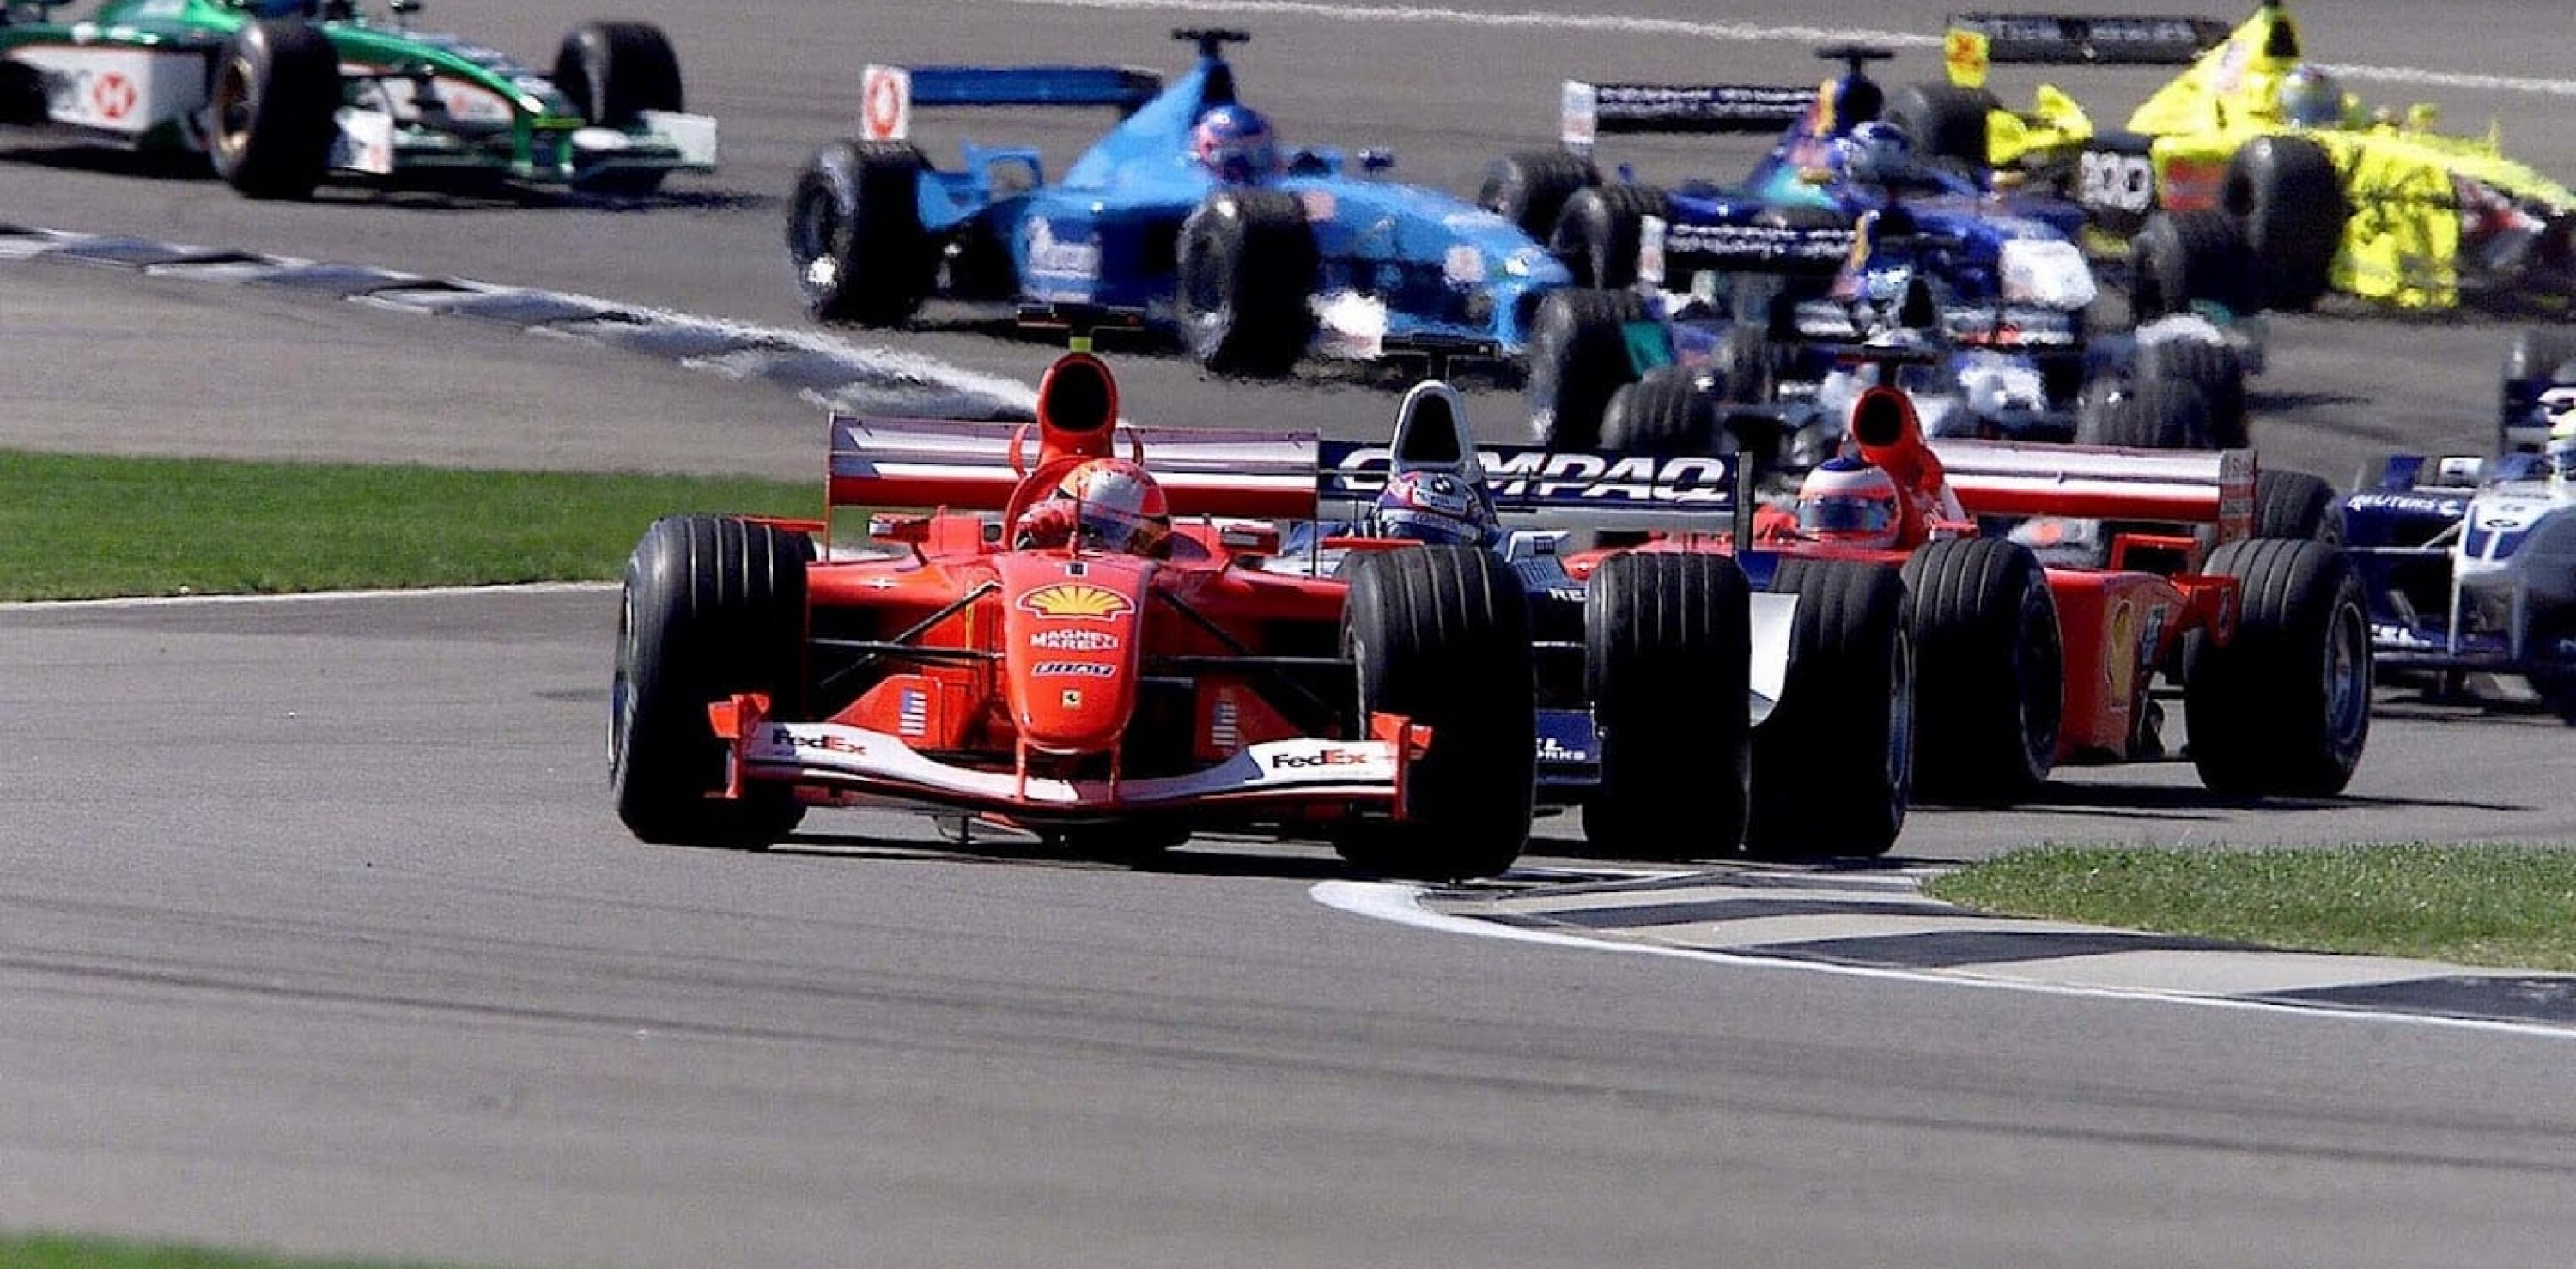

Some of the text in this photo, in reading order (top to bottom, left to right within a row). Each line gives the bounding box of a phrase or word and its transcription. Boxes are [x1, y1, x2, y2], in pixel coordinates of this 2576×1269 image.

[1338, 448, 1727, 503] CMPAQ
[772, 729, 866, 755] FedEx
[1272, 749, 1368, 768] FedEx
